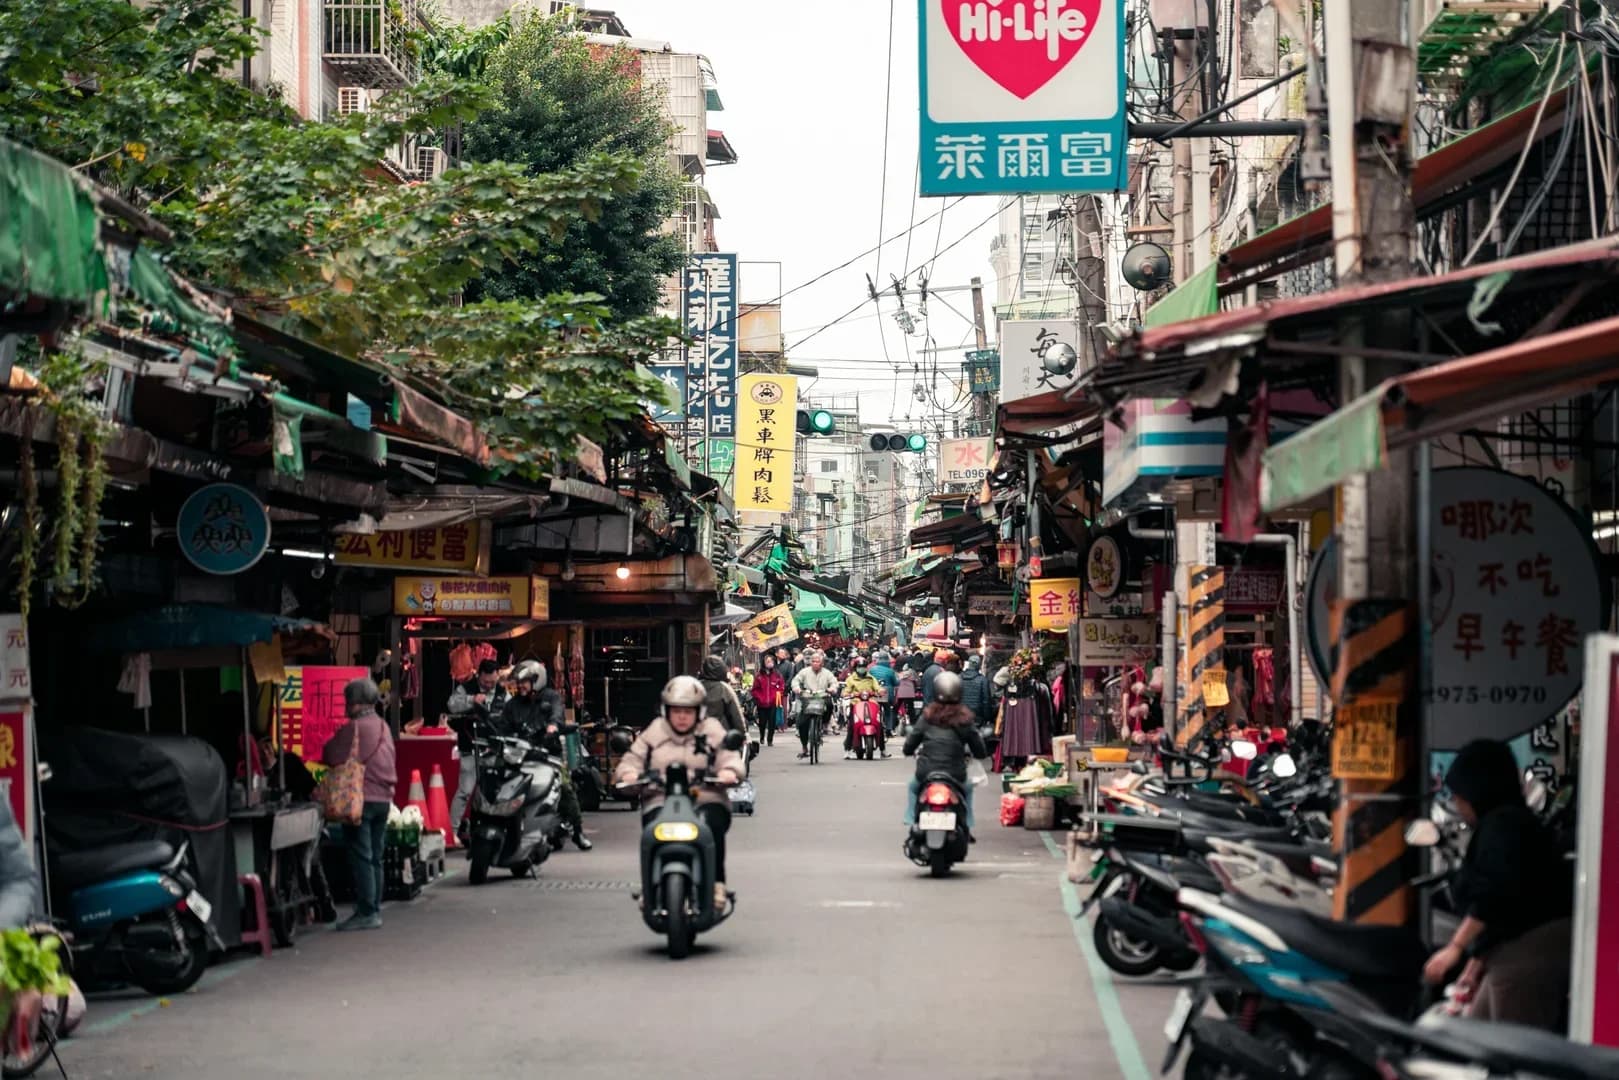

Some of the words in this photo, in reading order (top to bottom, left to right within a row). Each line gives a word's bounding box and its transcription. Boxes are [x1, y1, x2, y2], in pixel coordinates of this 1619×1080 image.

[934, 131, 1112, 180] 萊爾富
[751, 407, 777, 504] 黑車牌肉鬆
[954, 442, 984, 467] 水
[1440, 498, 1535, 541] 哪次
[1478, 552, 1561, 599] 不吃
[1453, 611, 1581, 677] 早午餐
